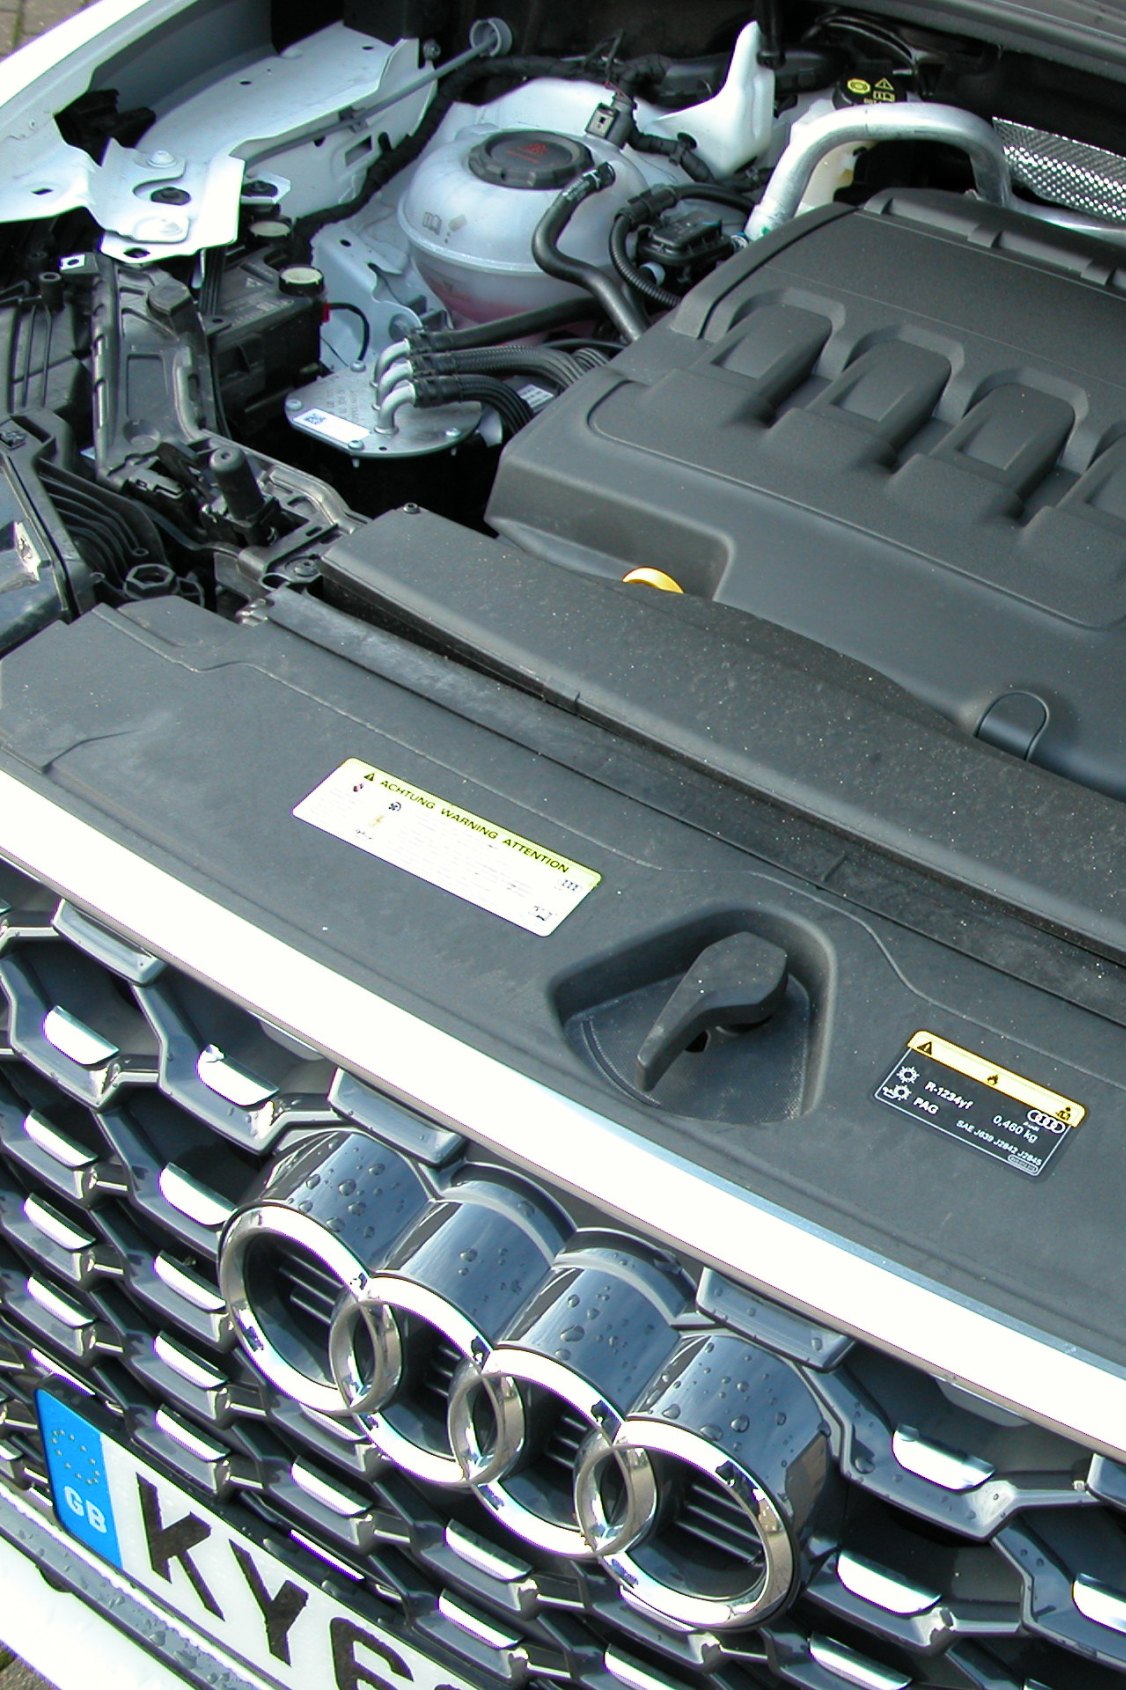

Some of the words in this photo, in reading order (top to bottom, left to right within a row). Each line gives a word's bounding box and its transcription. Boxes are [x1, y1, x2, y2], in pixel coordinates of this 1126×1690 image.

[380, 779, 436, 809] ACHTUNG
[440, 808, 499, 840] WARNING
[502, 838, 570, 874] ATTENTION
[913, 1097, 939, 1115] PAG
[924, 1081, 974, 1110] R-1234yf
[956, 1120, 974, 1134] SAE
[992, 1115, 1024, 1135] 0,460
[1023, 1128, 1038, 1144] kg
[64, 1485, 107, 1534] GB
